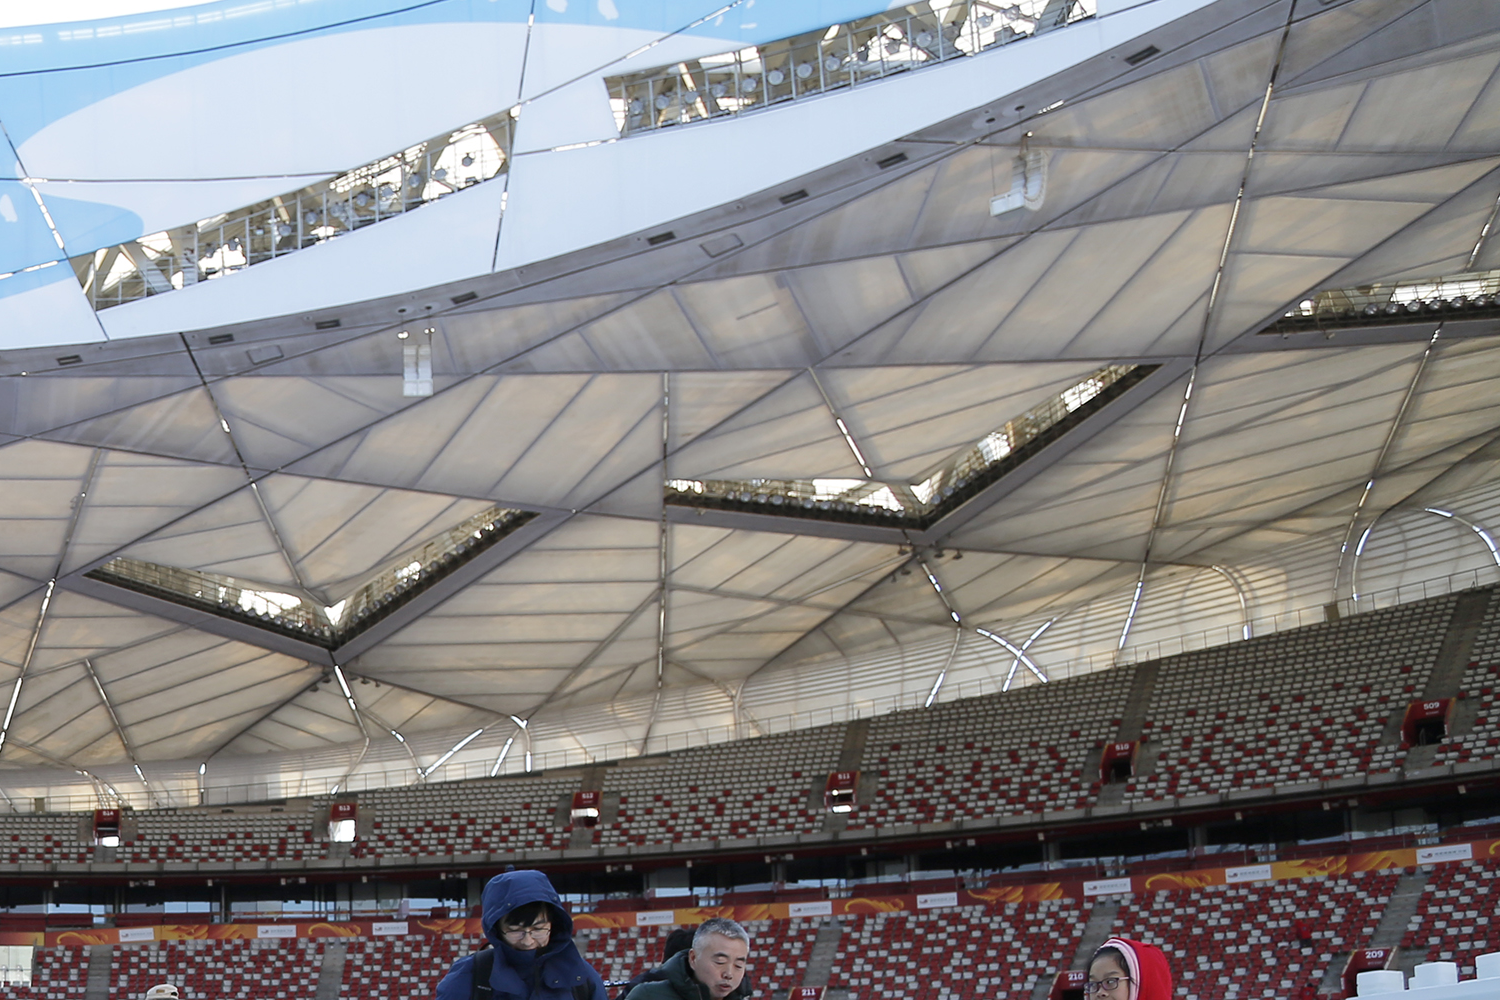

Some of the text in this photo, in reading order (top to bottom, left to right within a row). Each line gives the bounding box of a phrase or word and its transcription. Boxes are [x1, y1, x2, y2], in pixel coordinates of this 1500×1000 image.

[1423, 701, 1441, 709] 509
[1365, 950, 1384, 959] 209
[1068, 972, 1084, 981] 210
[801, 988, 817, 997] 211
